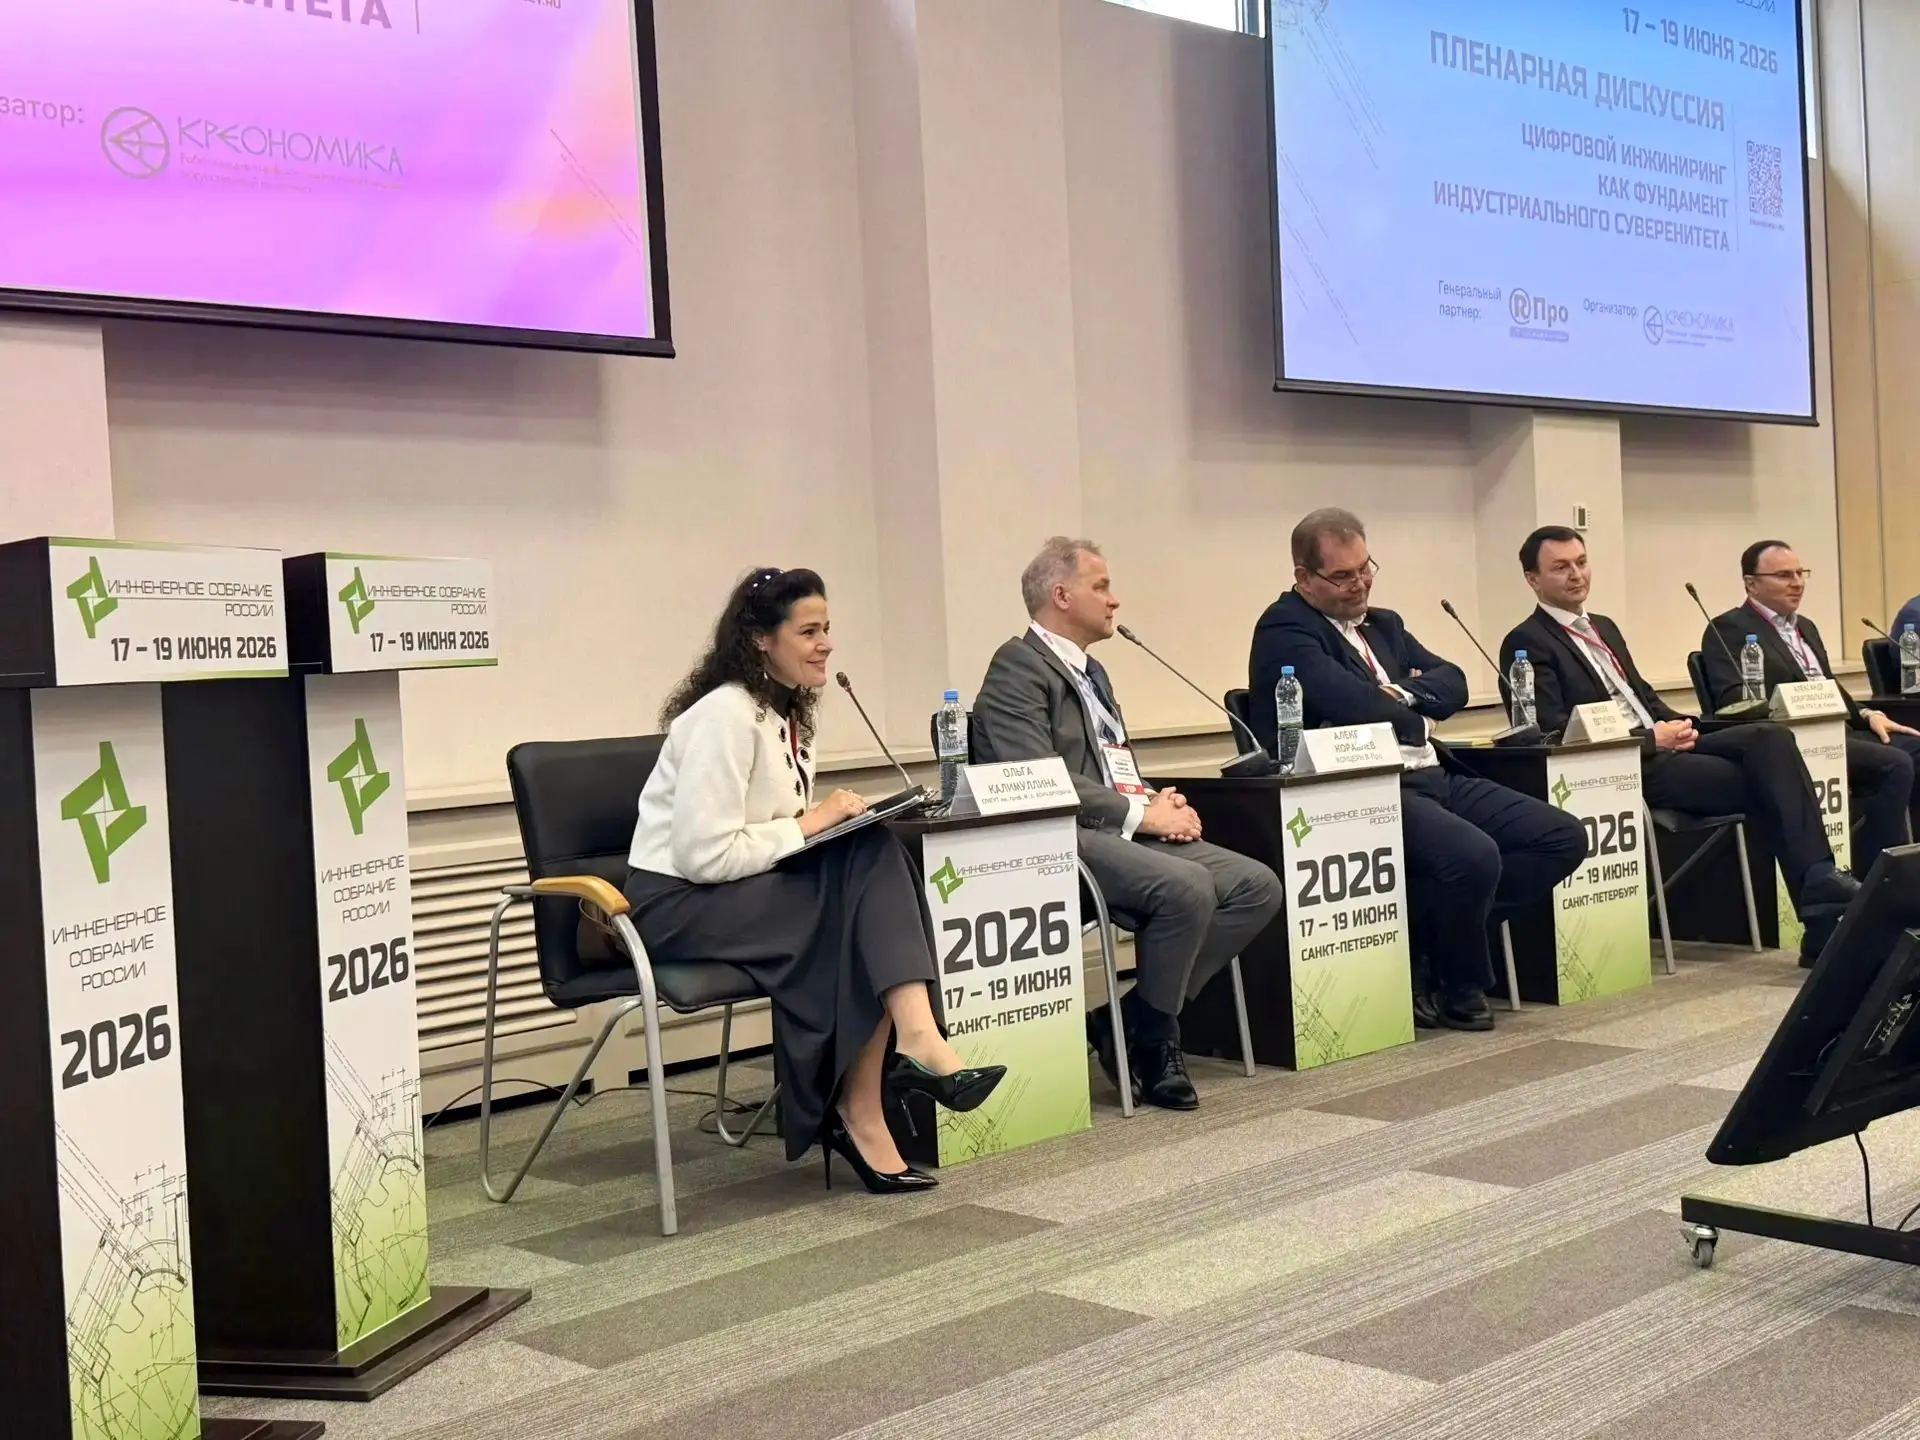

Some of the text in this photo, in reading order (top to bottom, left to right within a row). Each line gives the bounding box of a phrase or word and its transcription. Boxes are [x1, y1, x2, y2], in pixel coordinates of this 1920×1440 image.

[1623, 7, 1639, 34] 17
[1661, 18, 1678, 47] 19
[1684, 24, 1734, 62] ИЮНЯ
[1739, 41, 1777, 74] 2026
[1430, 30, 1725, 131] ПЛЕНАРНАЯ ДИСКУССИЯ
[177, 117, 403, 175] КРЕОНОМИКА
[1522, 122, 1727, 185] ЦИФРОВОЙ ИНЖИНИРИНГ
[1598, 174, 1729, 219] КАК ФУНДАМЕНТ
[1433, 180, 1730, 252] ИНДУСТРИАЛЬНОГО СУВЕРЕНИТЕТА
[1438, 279, 1502, 301] Генеральный
[1439, 303, 1482, 322] партнер:
[107, 579, 273, 597] ИНЖЕНЕРНОЕ СОБРАНИЕ
[367, 584, 486, 599] ИНЖЕНЕРНОЕ СОБРАНИЕ
[225, 603, 274, 617] РОССИИ
[451, 603, 486, 615] РОССИИ
[111, 638, 130, 661] 17
[153, 637, 172, 660] 19
[178, 637, 231, 660] ИЮНЯ
[236, 637, 277, 659] 2026
[370, 632, 384, 652] 17
[400, 631, 414, 651] 19
[417, 631, 457, 650] ИЮНЯ
[460, 631, 489, 650] 2026
[988, 778, 1058, 794] КАЛИМУЛЛИНА
[1002, 766, 1034, 778] ОЛЬГА
[1360, 804, 1398, 817] СОБРАНИЕ
[1813, 777, 1842, 815] 26
[1369, 815, 1399, 825] РОССИИ
[1580, 811, 1637, 859] 026
[321, 855, 405, 883] ИНЖЕНЕРНОЕ
[957, 851, 1073, 876] ИНЖЕНЕРНОЕ СОБРАНИЕ
[1037, 863, 1074, 876] РОССИИ
[1296, 847, 1396, 908] 2026
[1587, 868, 1599, 884] 19
[1602, 860, 1638, 882] ИЮНЯ
[333, 877, 396, 903] СОБРАНИЕ
[1562, 885, 1639, 910] САНКТ-ПЕТЕРБУРГ
[52, 905, 167, 944] ИНЖЕНЕРНОЕ
[342, 900, 390, 923] РОССИИ
[1299, 918, 1314, 937] 17
[1332, 912, 1348, 931] 19
[1352, 903, 1397, 927] ИЮНЯ
[69, 933, 154, 968] СОБРАНИЕ
[943, 901, 1070, 975] 2026
[1301, 930, 1399, 962] САНКТ-ПЕТЕРБУРГ
[81, 961, 146, 992] РОССИИ
[327, 936, 409, 1003] 2026
[945, 986, 964, 1009] 17
[988, 978, 1008, 1001] 19
[1014, 966, 1071, 995] ИЮНЯ
[947, 998, 1072, 1038] САНКТ-ПЕТЕРБУРГ
[60, 1004, 171, 1090] 2026
